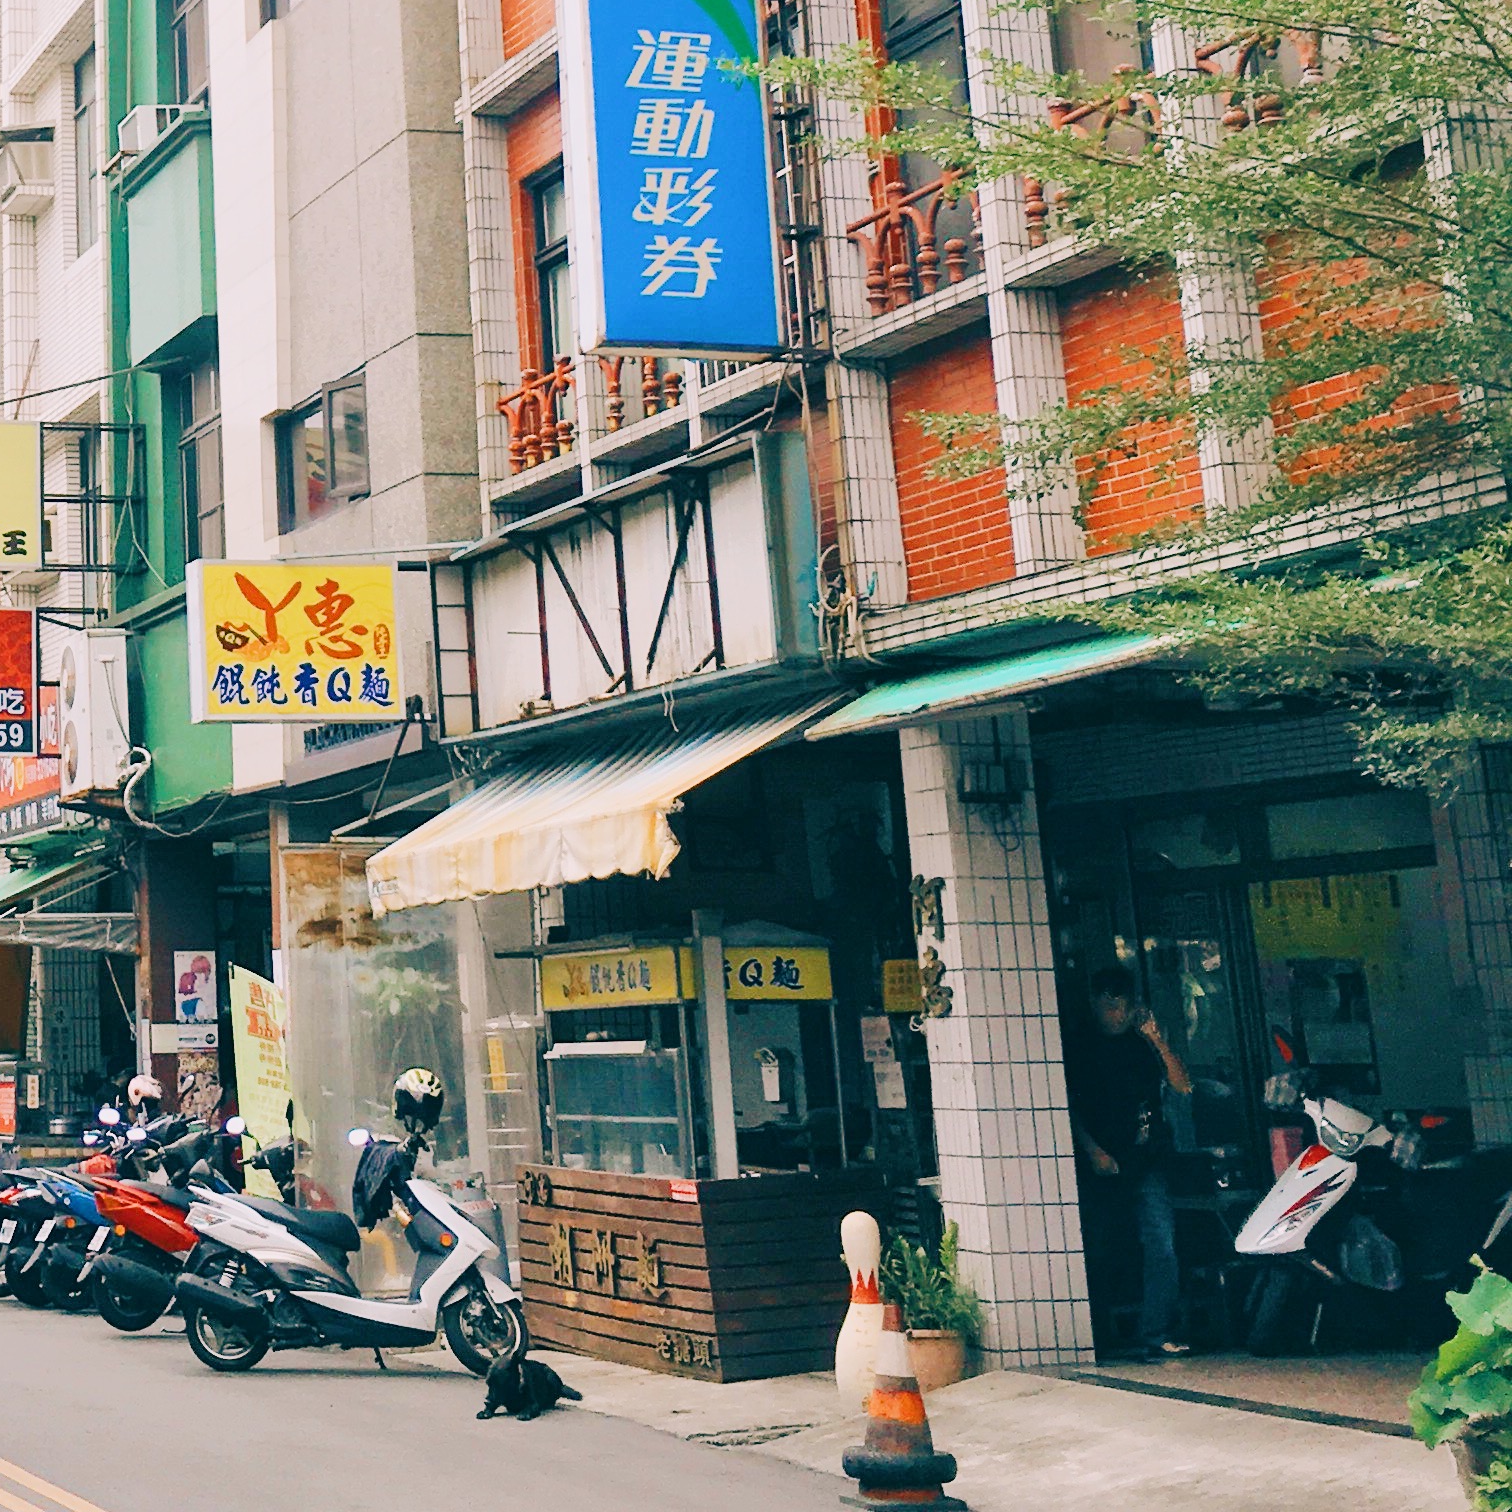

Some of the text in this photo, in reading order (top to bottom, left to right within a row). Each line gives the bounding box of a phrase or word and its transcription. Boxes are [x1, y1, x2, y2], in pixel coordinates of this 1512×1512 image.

[625, 28, 724, 299] 運動彩券
[212, 662, 395, 707] 餛飩香Q麵
